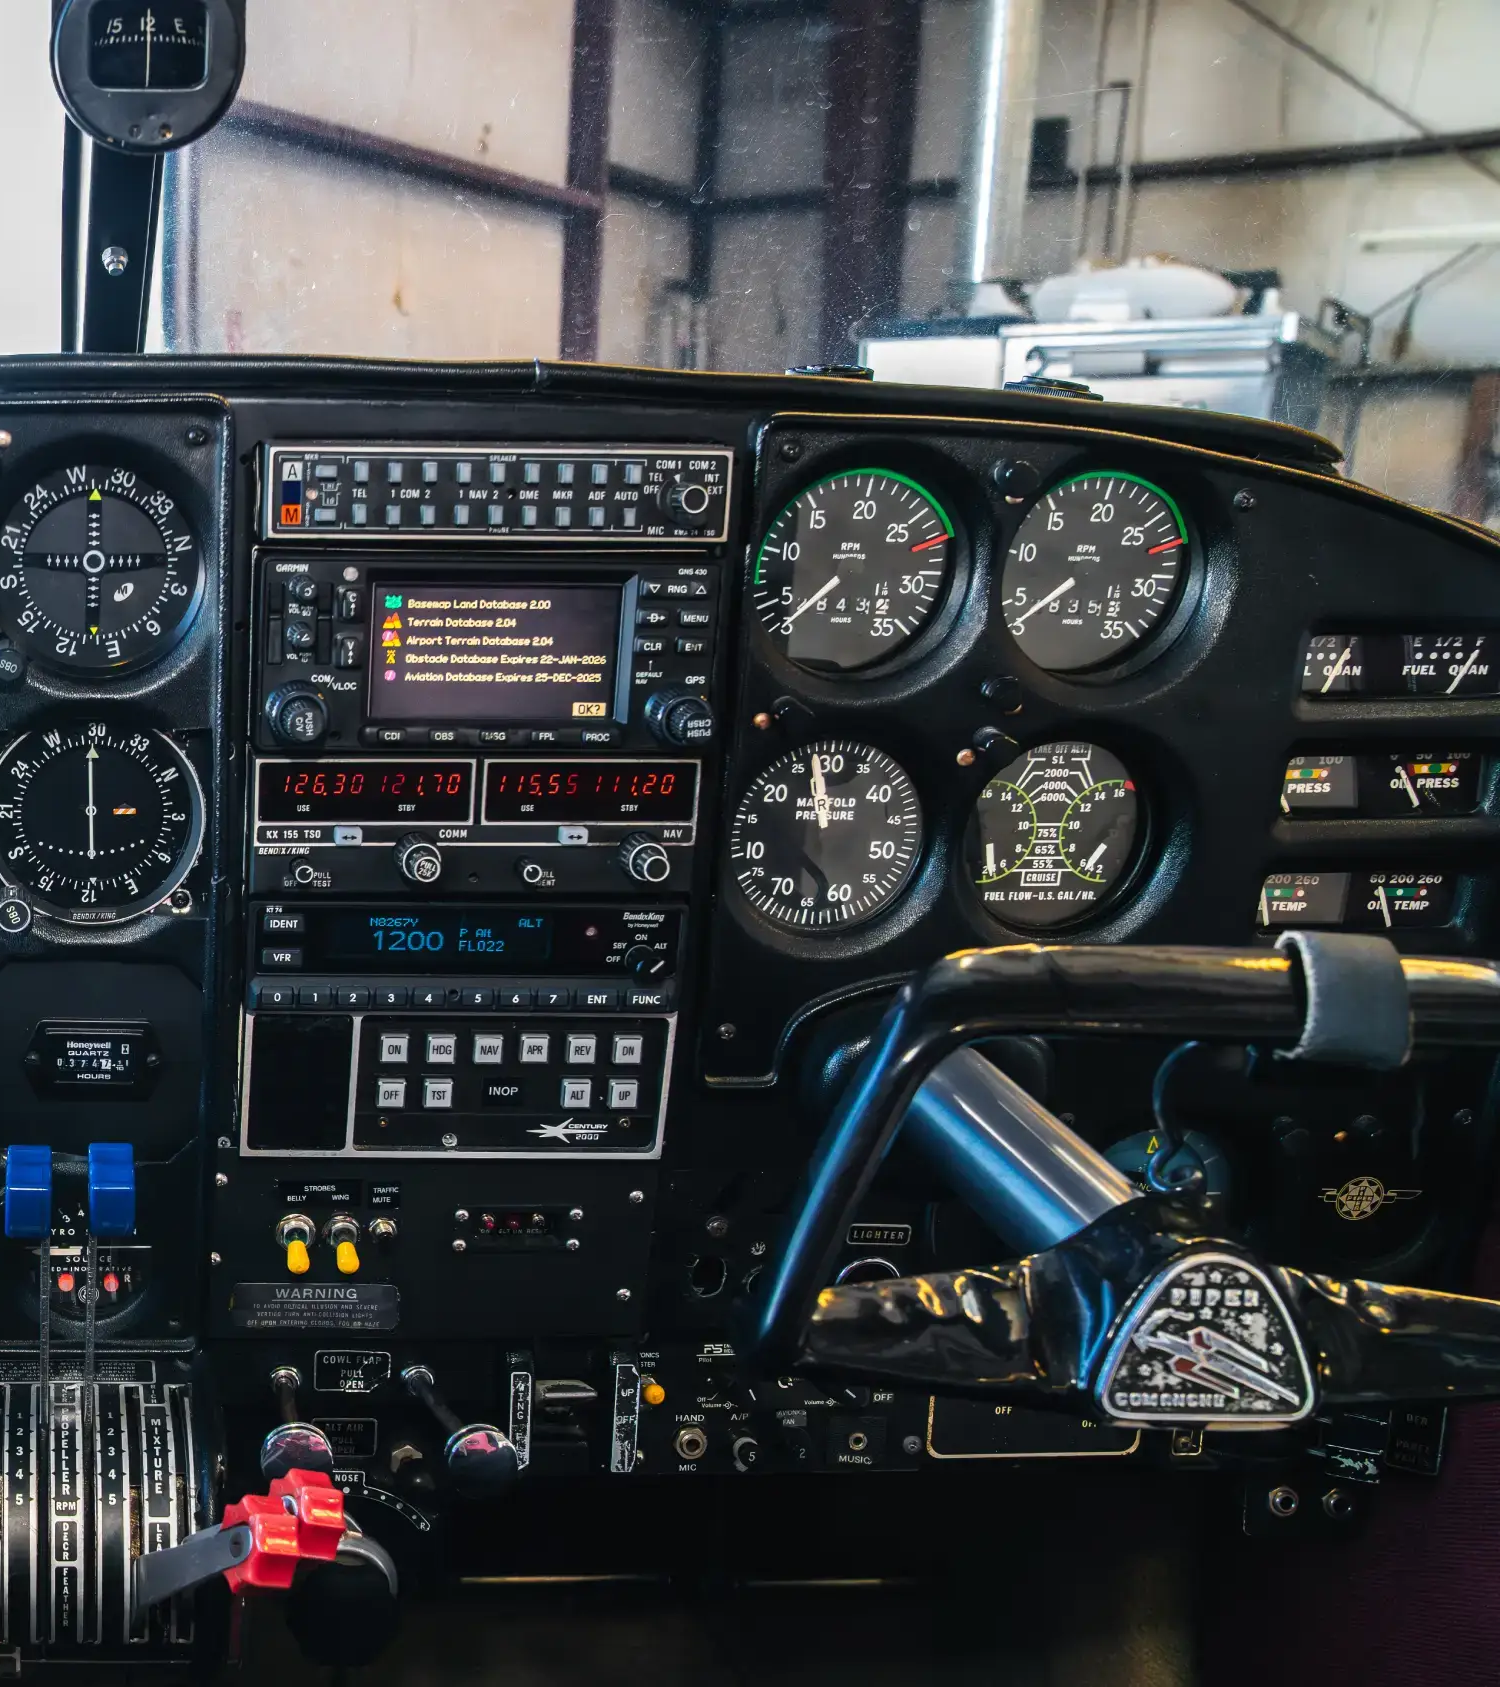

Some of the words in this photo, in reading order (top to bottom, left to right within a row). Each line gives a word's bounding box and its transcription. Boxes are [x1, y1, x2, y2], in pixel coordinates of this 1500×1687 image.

[704, 474, 719, 484] INT
[352, 489, 368, 498] TEL
[519, 490, 539, 500] DME
[552, 490, 573, 500] MKR
[708, 485, 724, 495] EXT
[588, 490, 606, 501] ADF
[614, 491, 638, 501] AUTO
[810, 511, 826, 529] 15
[647, 526, 665, 536] MIC
[886, 524, 908, 542] 25
[841, 543, 860, 551] RPM
[276, 564, 309, 572] GARMIN
[667, 584, 687, 594] RNG
[408, 599, 451, 610] Basemap
[454, 600, 477, 609] Land
[480, 600, 527, 609] Database
[530, 600, 551, 609] 2.00
[407, 617, 443, 627] Terrain
[446, 618, 493, 628] Database
[496, 619, 516, 628] 2.04
[683, 614, 708, 623] MENU
[407, 636, 442, 647] Airport
[445, 636, 480, 645] Terrain
[483, 637, 530, 646] Database
[532, 637, 553, 646] 2.04
[644, 642, 661, 651] CLR
[405, 654, 448, 664] Obstacle
[451, 654, 498, 664] Database
[501, 655, 538, 665] Expires
[540, 655, 606, 664] 22-JAN-2026
[1402, 665, 1436, 675] FUEL
[405, 672, 443, 682] Aviation
[446, 673, 493, 682] Database
[496, 673, 533, 683] Expires
[535, 673, 601, 682] 25-DEC-2025
[685, 675, 705, 685] GPS
[578, 705, 600, 714] OK?
[384, 732, 401, 741] CDI
[539, 732, 554, 741] FPL
[585, 732, 610, 742] PROC
[284, 774, 364, 796] 126.30
[381, 774, 461, 796] 121.70
[500, 774, 577, 796] 115.55
[595, 774, 674, 796] 111.20
[1287, 783, 1331, 794] PRESS
[764, 784, 787, 803] 20
[267, 829, 279, 839] KX
[283, 829, 299, 839] 155
[304, 829, 321, 839] TSO
[439, 829, 468, 839] COMM
[663, 828, 683, 838] NAV
[1038, 829, 1057, 838] 75%
[869, 841, 895, 859] 50
[1026, 874, 1056, 882] CRUISE
[985, 892, 1005, 901] FUEL
[1271, 901, 1307, 911] TEMP
[269, 919, 298, 928] IDENT
[370, 918, 419, 927] N8267Y
[373, 930, 444, 951] 1200
[459, 940, 505, 953] FL022
[273, 953, 291, 962] VFR
[587, 995, 607, 1004] ENT
[632, 995, 660, 1005] FUNC
[67, 1041, 111, 1049] Honeywell
[388, 1044, 402, 1056] ON
[432, 1044, 452, 1056] HDG
[480, 1044, 499, 1056] NAV
[526, 1043, 543, 1056] APR
[574, 1045, 591, 1056] REV
[383, 1089, 399, 1101] OFF
[432, 1090, 447, 1101] TST
[489, 1086, 518, 1096] INOP
[570, 1090, 585, 1101] ALT
[618, 1090, 631, 1101] UP
[853, 1230, 905, 1240] LIGHTER
[276, 1289, 357, 1299] WARNING
[323, 1356, 351, 1364] COWL
[839, 1455, 871, 1464] MUSIC
[56, 1501, 76, 1511] RPM
